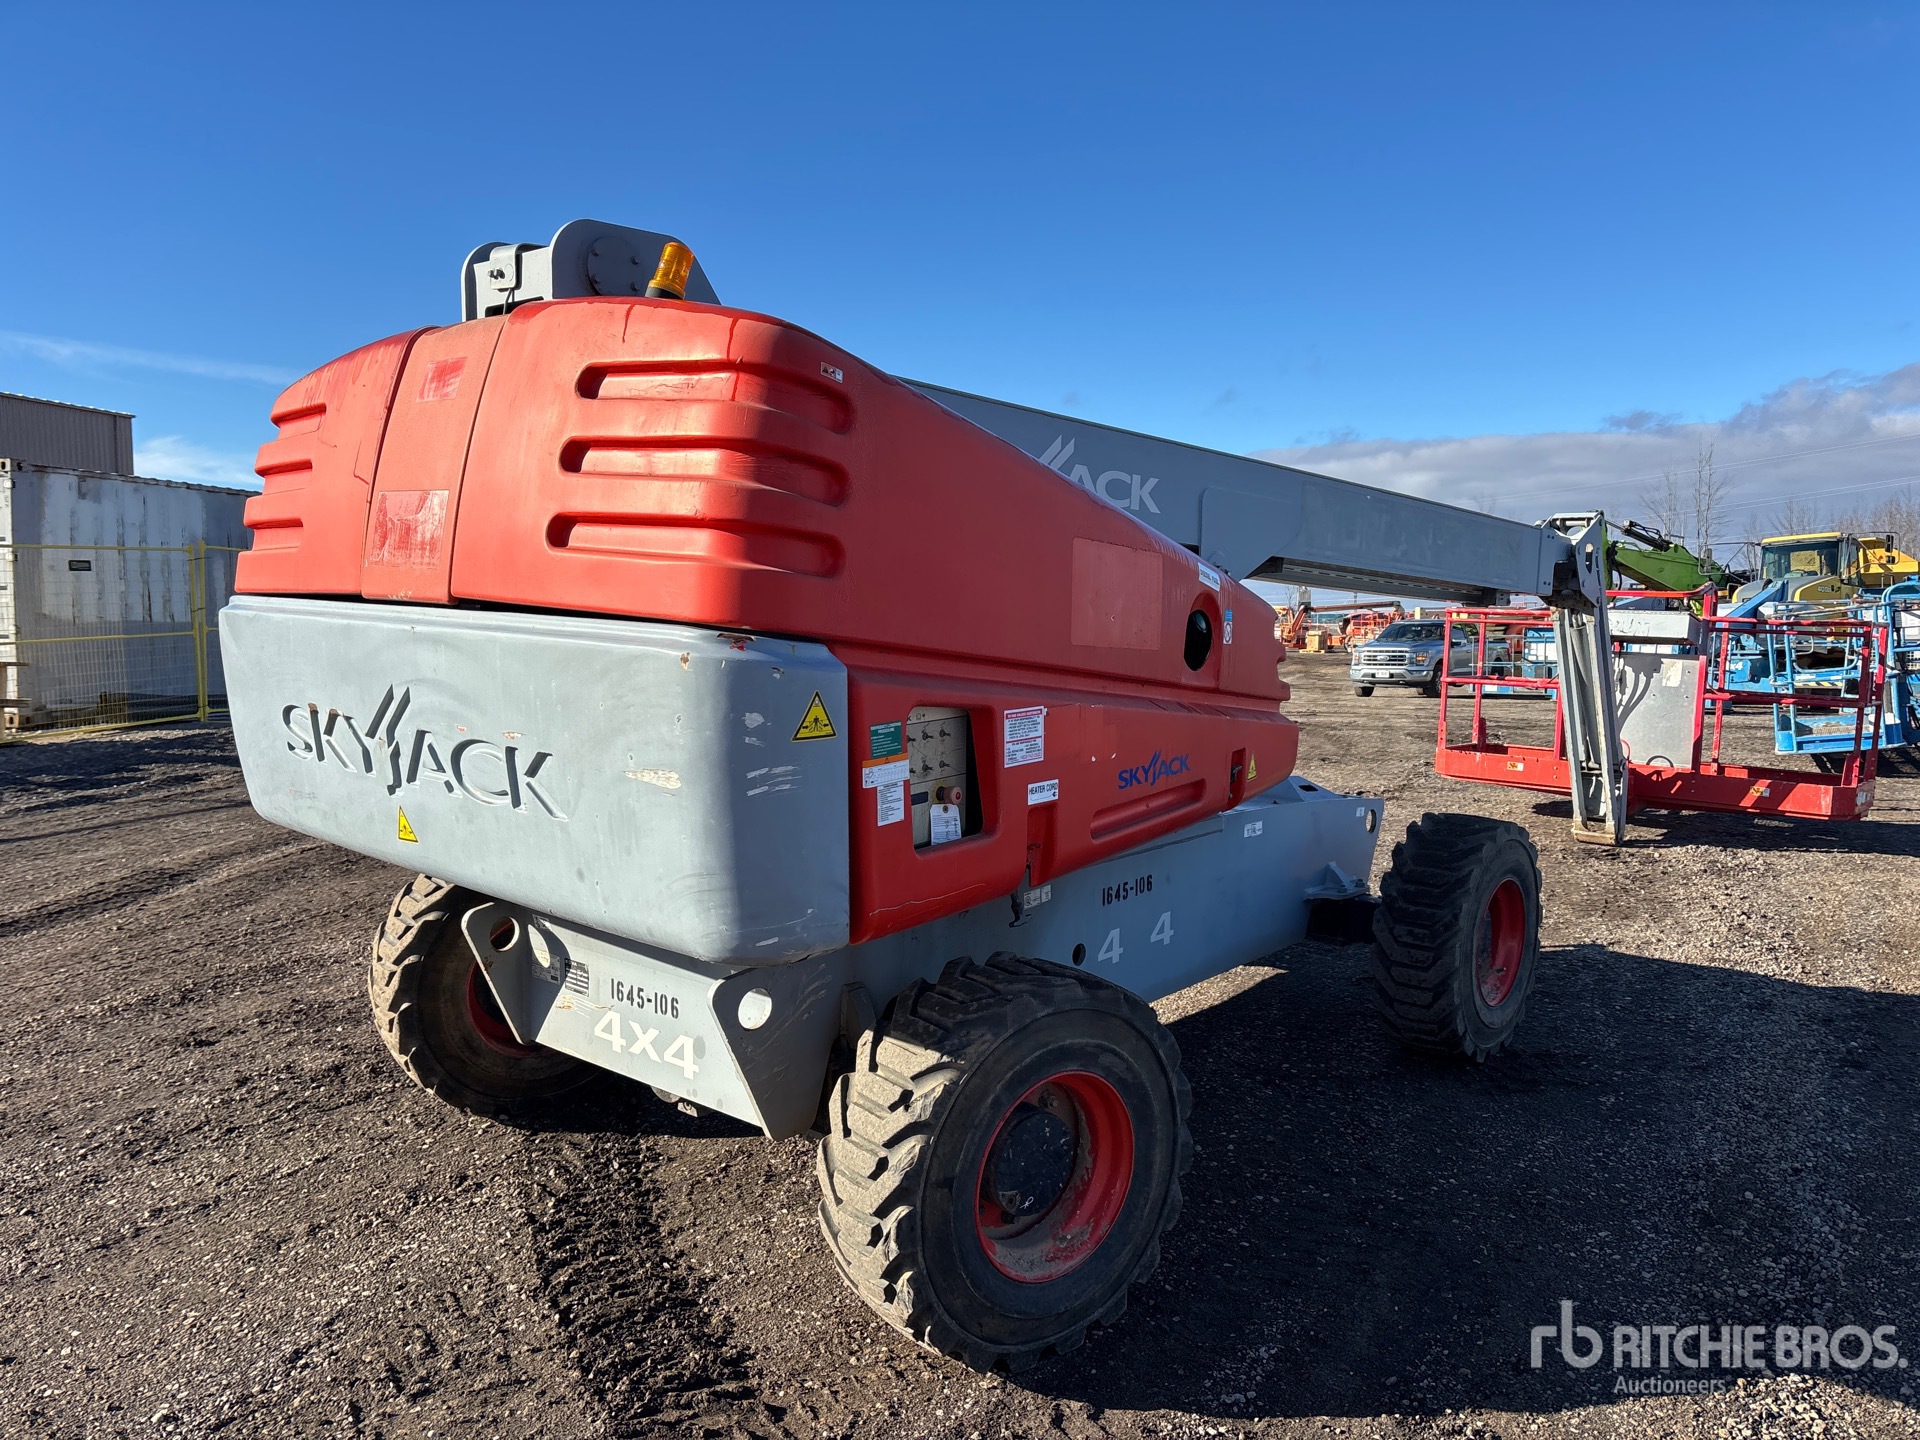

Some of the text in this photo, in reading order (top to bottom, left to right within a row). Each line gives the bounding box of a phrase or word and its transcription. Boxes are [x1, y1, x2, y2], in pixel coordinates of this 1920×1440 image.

[282, 684, 569, 821] SKYJACK
[1118, 750, 1190, 789] SKYJACK
[1029, 782, 1058, 795] HEATER CORD
[1102, 874, 1153, 907] 1645-106
[611, 978, 679, 1019] 1645-106
